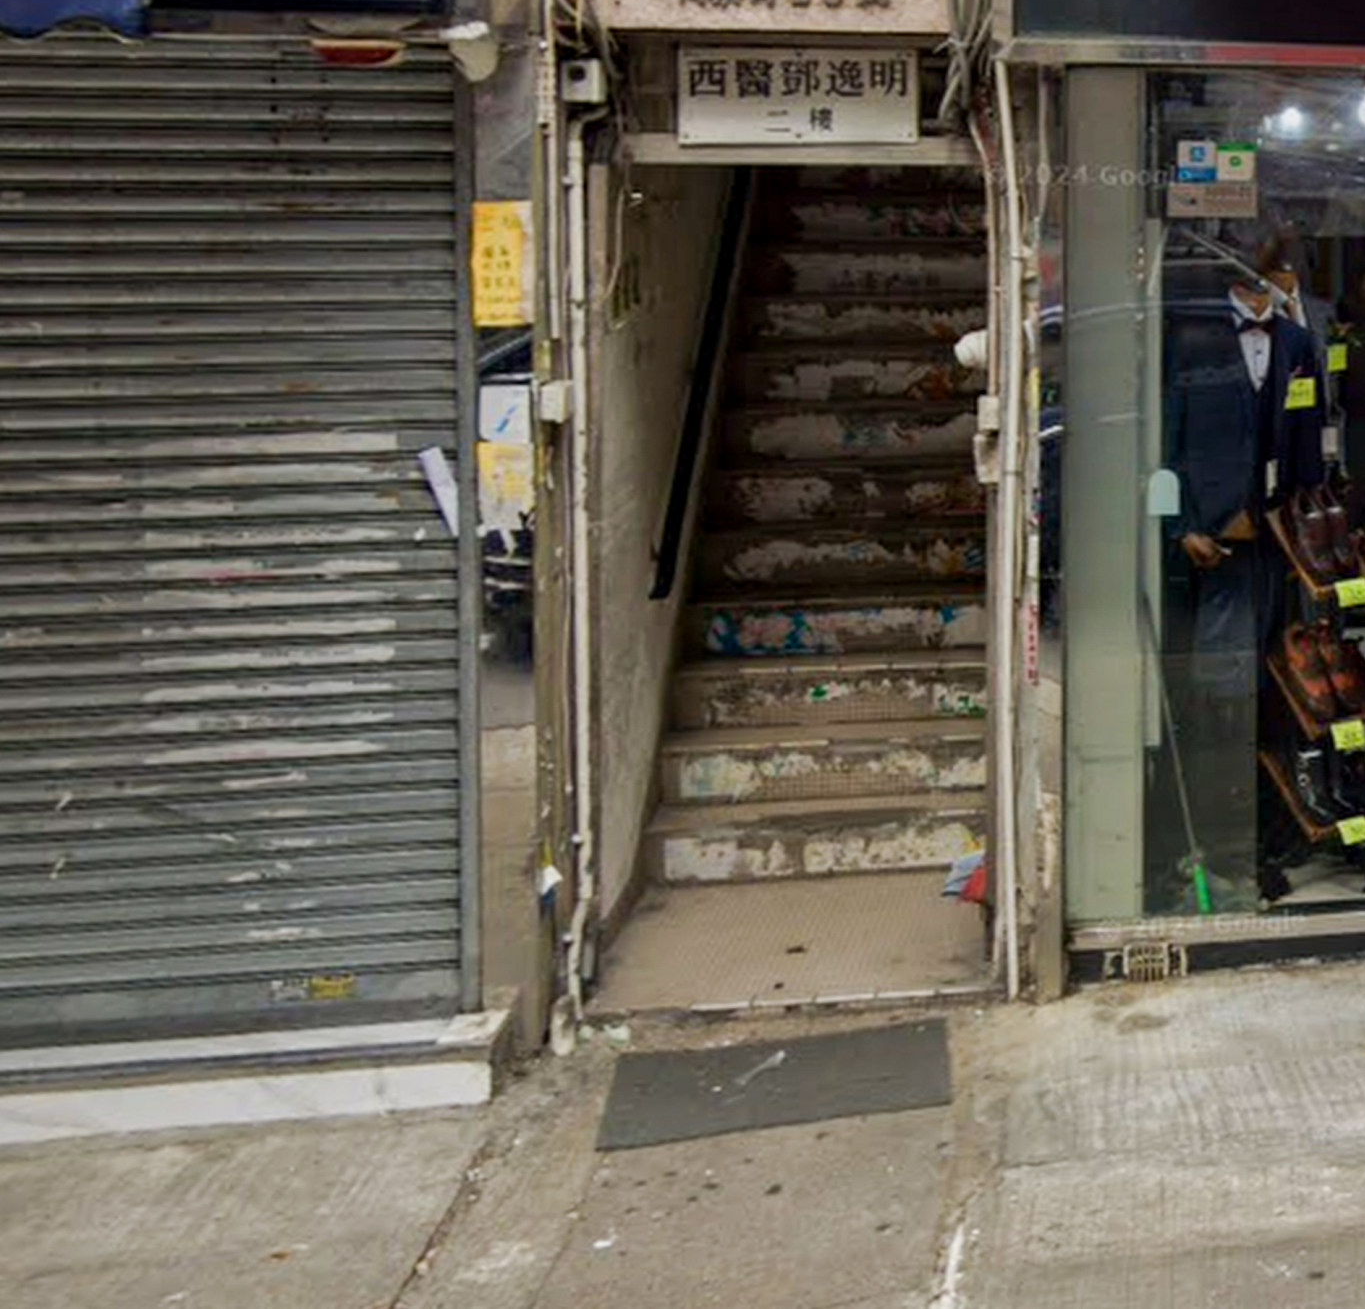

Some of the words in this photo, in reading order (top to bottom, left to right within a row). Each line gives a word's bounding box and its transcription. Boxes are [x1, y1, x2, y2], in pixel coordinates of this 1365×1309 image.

[687, 58, 910, 100] 西醫鄧逸明
[763, 106, 834, 133] 二樓
